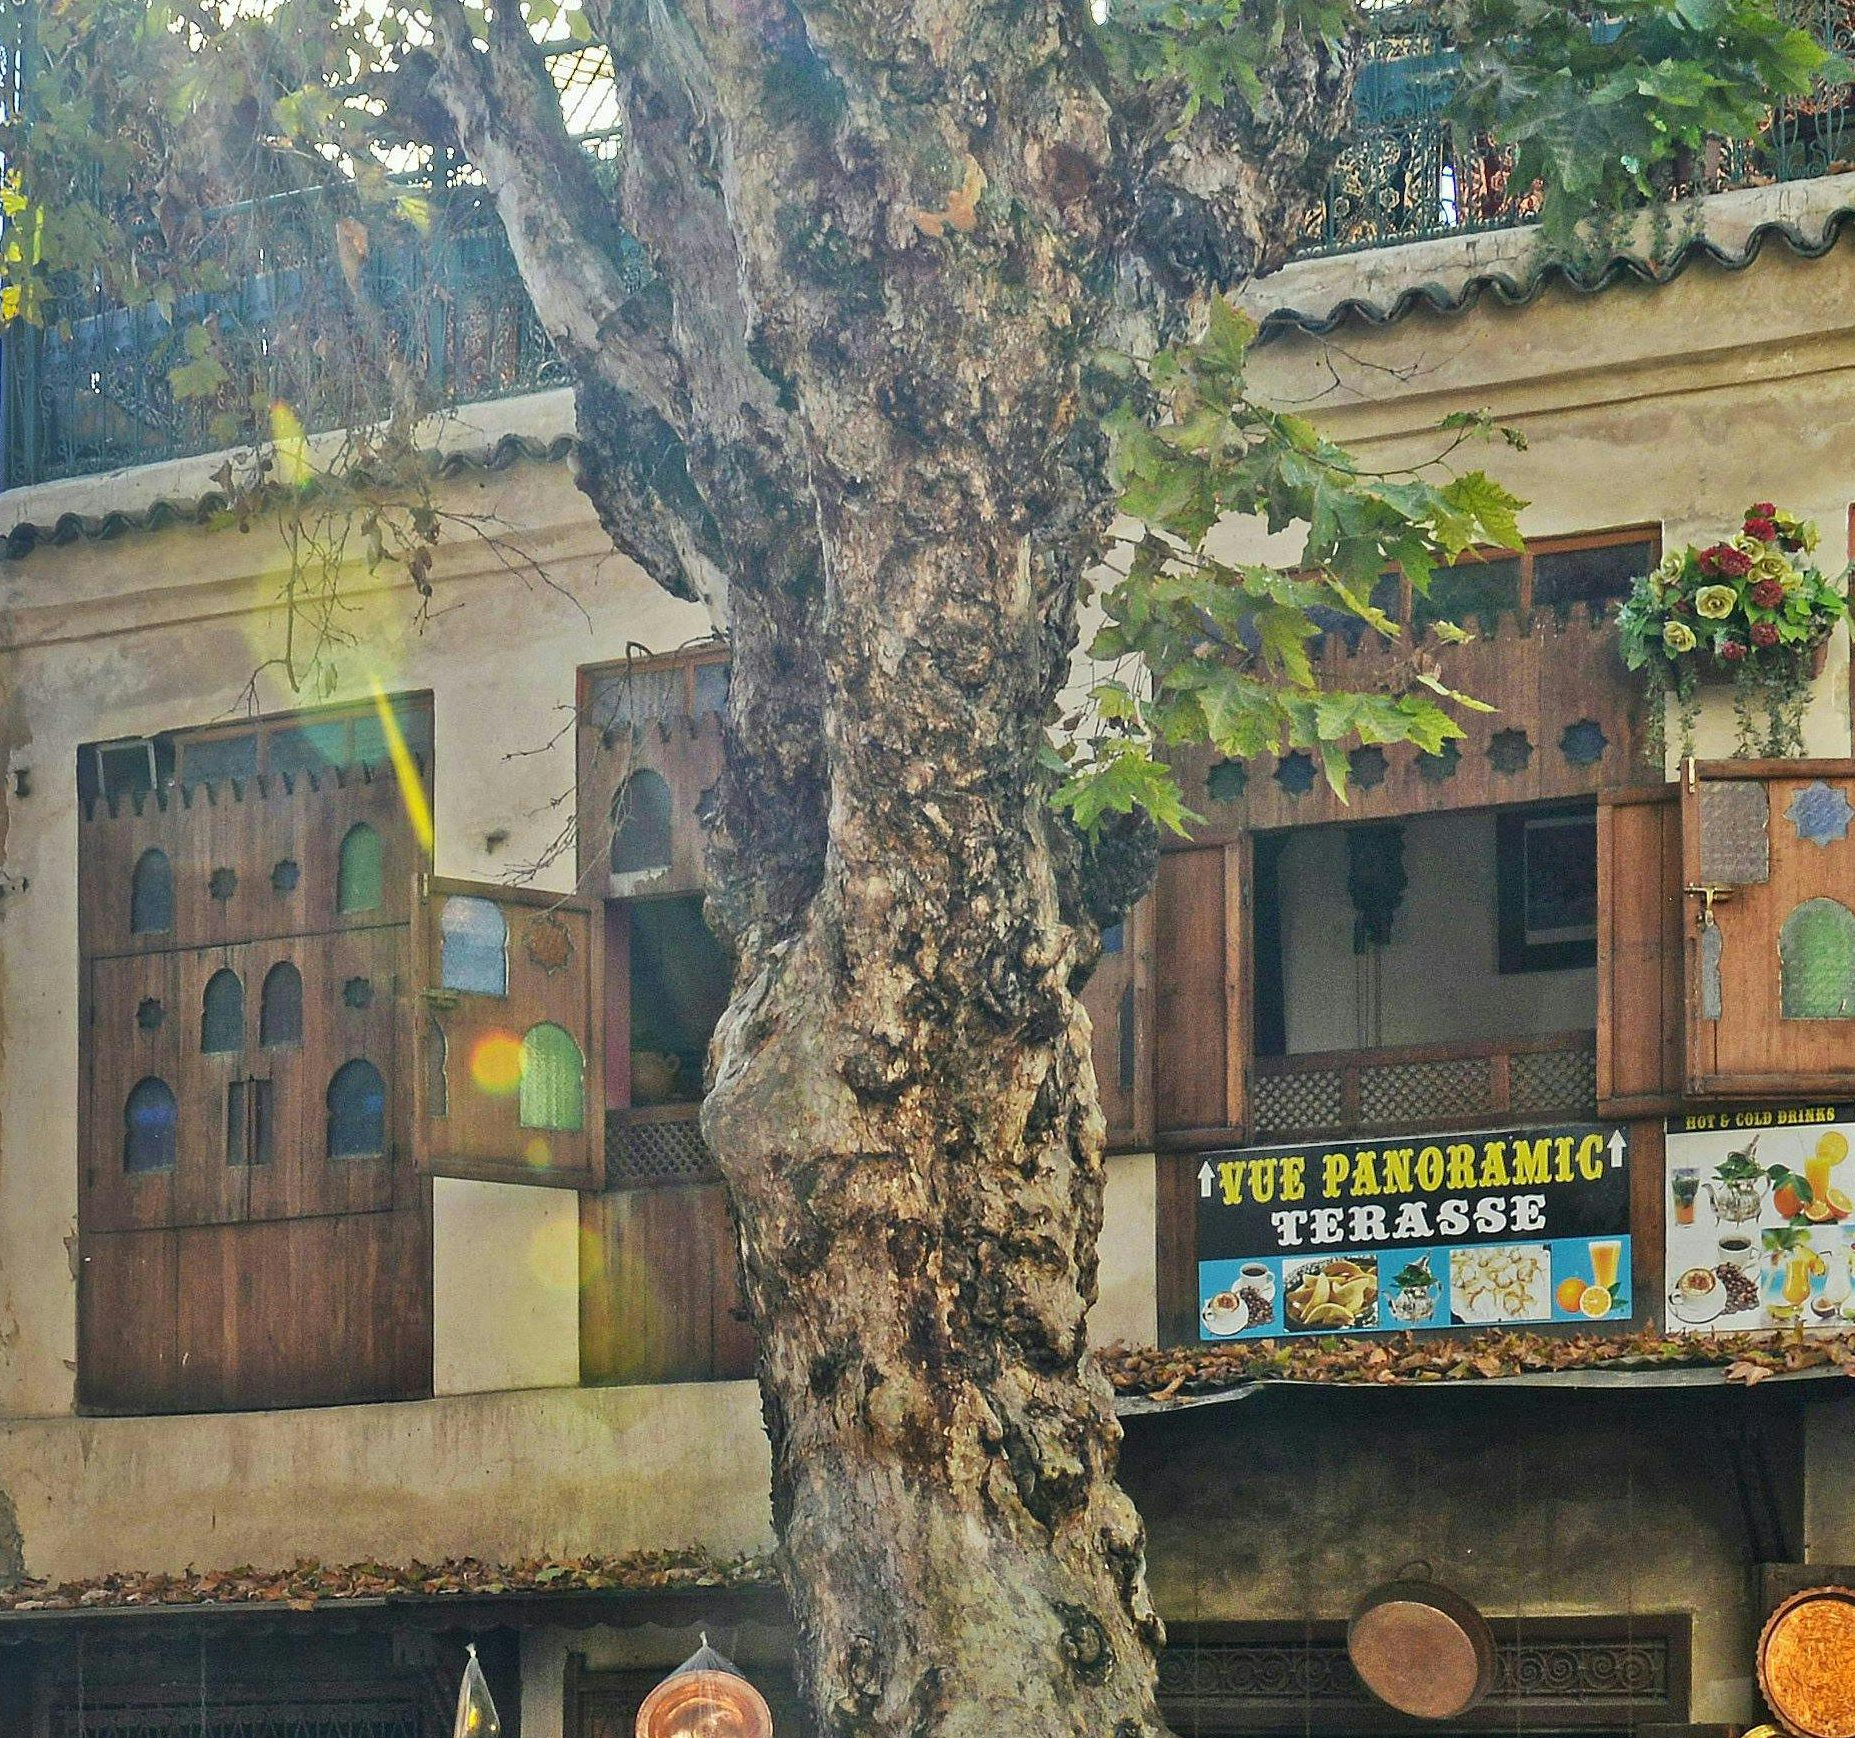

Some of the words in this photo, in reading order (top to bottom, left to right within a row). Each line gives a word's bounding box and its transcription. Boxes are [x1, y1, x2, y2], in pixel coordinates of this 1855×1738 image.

[1685, 1113, 1717, 1131] HOT
[1720, 1113, 1731, 1128] &
[1735, 1110, 1771, 1127] COLD
[1777, 1107, 1836, 1124] DRINKS
[1217, 1155, 1306, 1206] VUE
[1322, 1134, 1605, 1199] PANORAMIC
[1271, 1194, 1547, 1246] TERASSE
